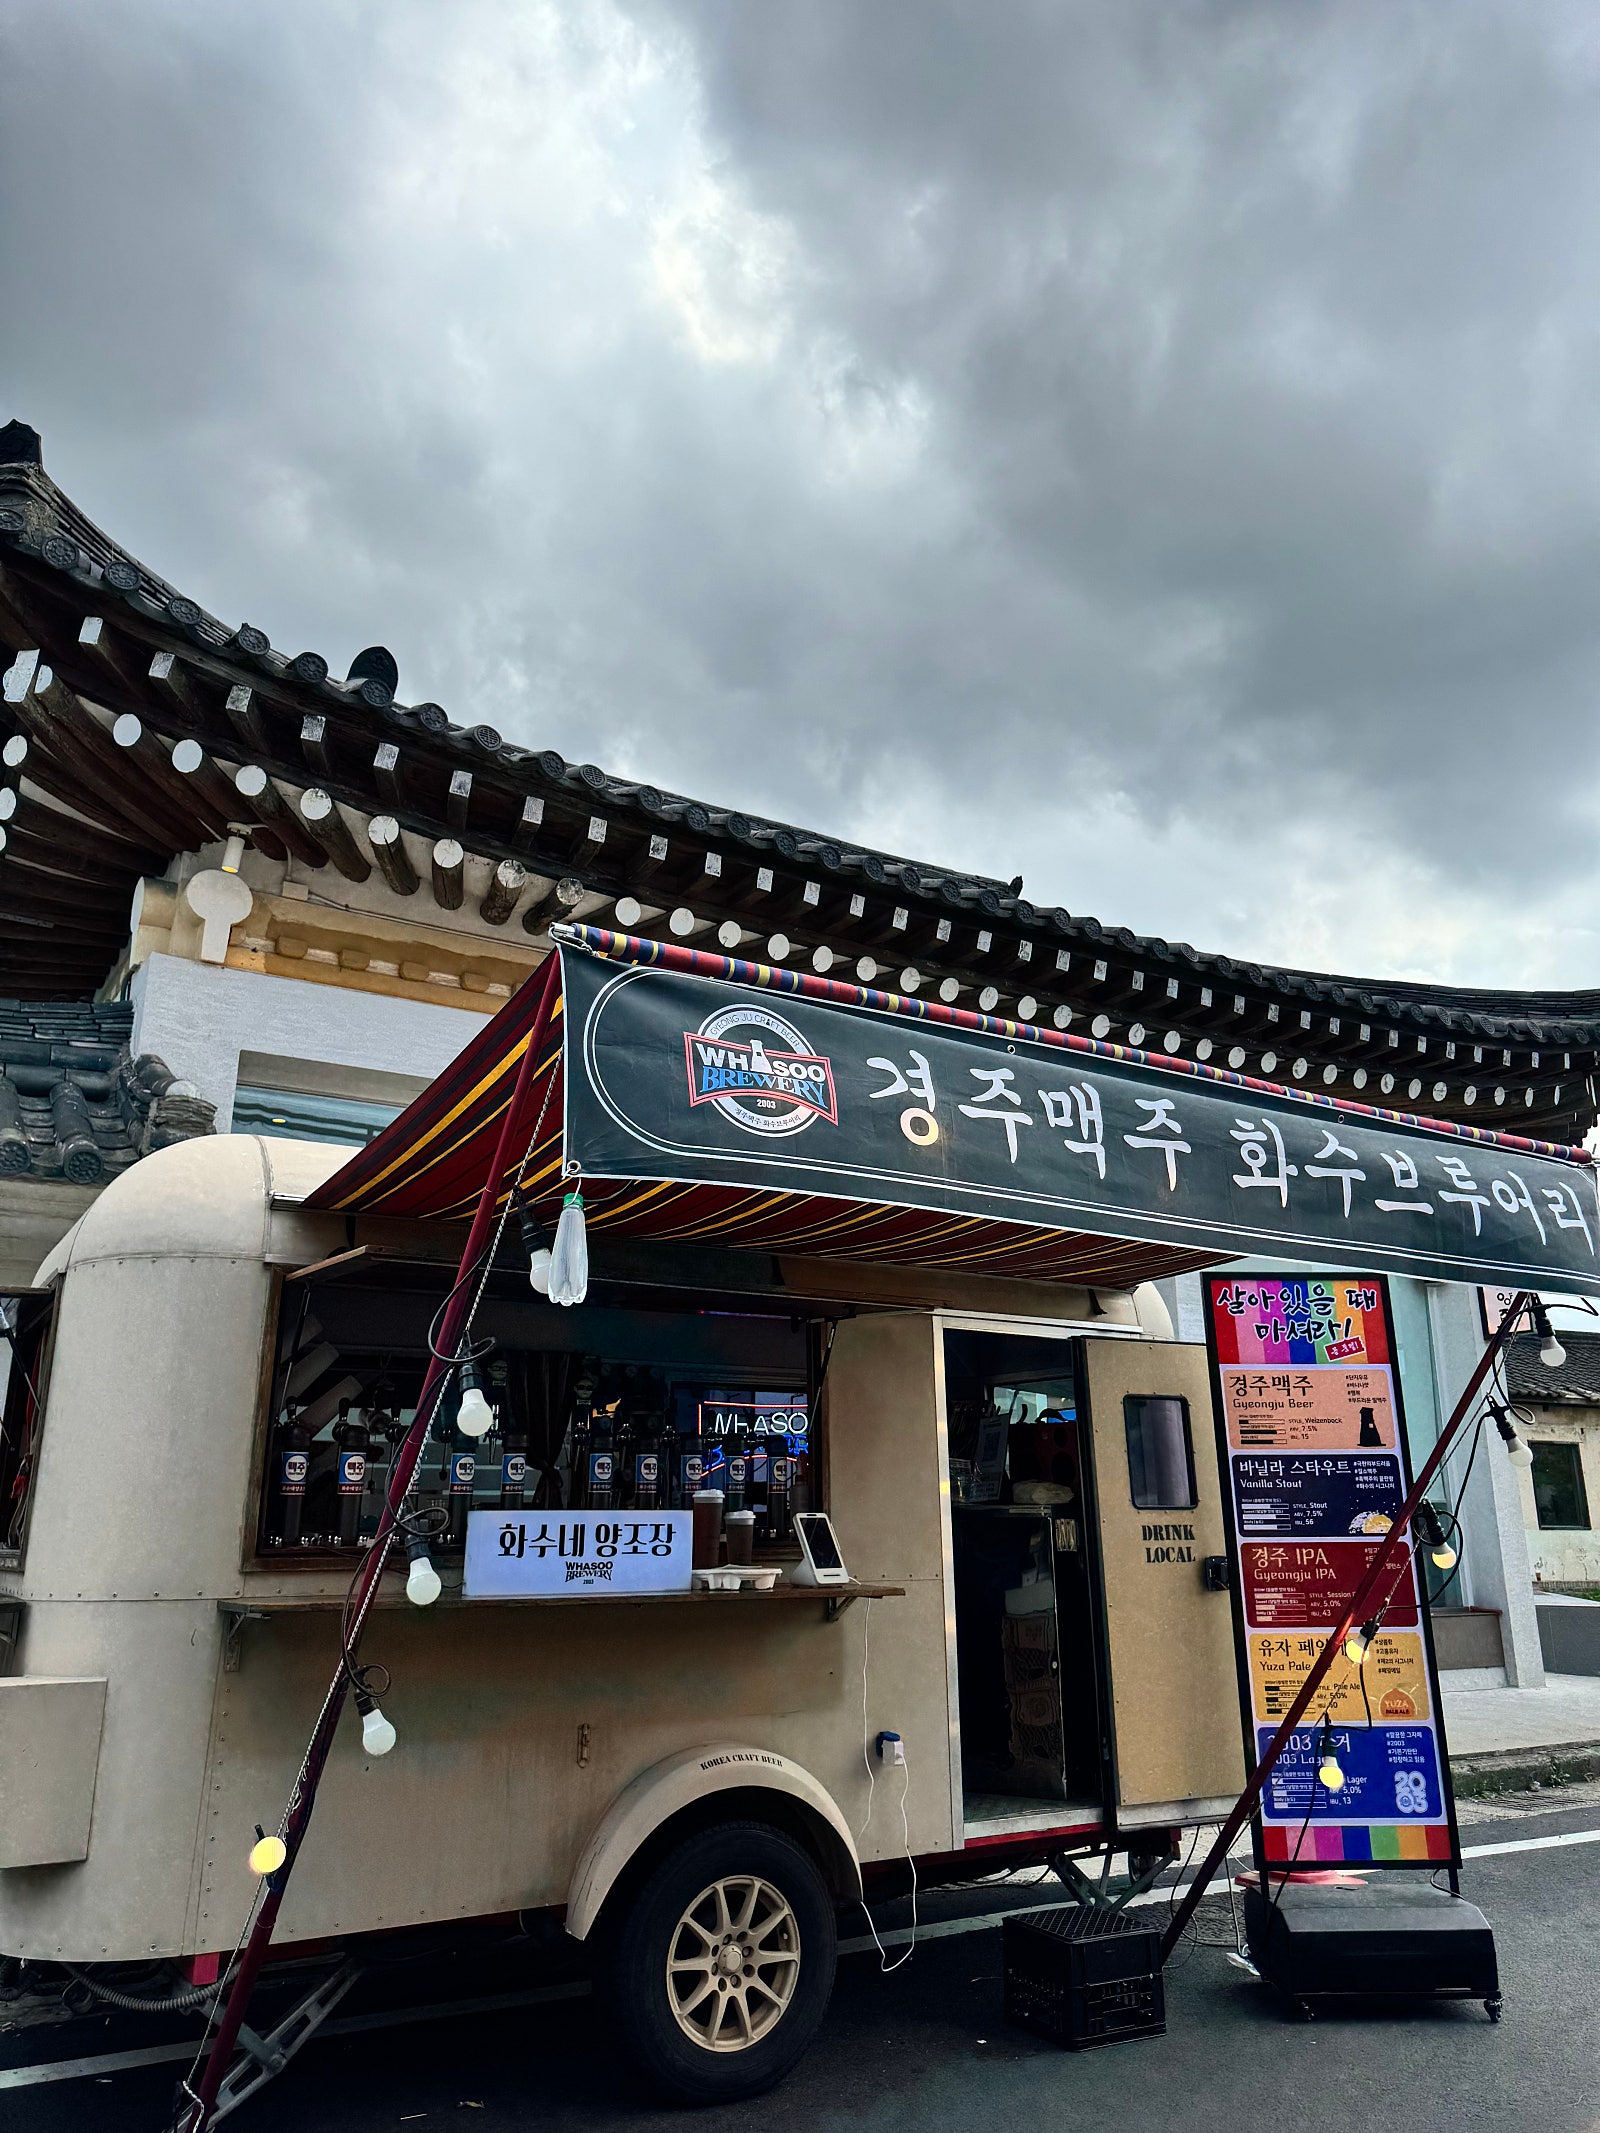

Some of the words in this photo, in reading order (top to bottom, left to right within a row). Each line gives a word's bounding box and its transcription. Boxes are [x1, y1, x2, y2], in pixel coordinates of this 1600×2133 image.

[710, 1014, 740, 1036] GYEONG
[780, 1027, 800, 1047] BEER
[699, 1065, 829, 1109] BREWERY
[756, 1099, 776, 1109] 2003
[866, 1049, 1193, 1193] 경주맥주
[1229, 1117, 1595, 1256] 화수브루어리
[1217, 1284, 1336, 1316] 살아있을
[1345, 1288, 1377, 1312] 때
[1254, 1317, 1353, 1344] 마셔라!
[1229, 1374, 1314, 1397] 경주맥주
[1233, 1398, 1285, 1410] Gyeongju
[1288, 1398, 1314, 1408] Beer
[287, 1461, 306, 1472] 맥주
[347, 1462, 364, 1472] 맥주
[459, 1462, 474, 1472] 맥주
[1239, 1459, 1285, 1477] 바닐라
[1290, 1459, 1351, 1477] 스타우트
[1240, 1478, 1273, 1488] Vanilla
[1276, 1479, 1303, 1488] Stout
[1141, 1524, 1196, 1541] DRINK
[498, 1522, 586, 1559] 화수네
[594, 1522, 677, 1558] 양조장
[1145, 1546, 1196, 1563] LOCAL
[1252, 1546, 1289, 1568] 경주
[1296, 1548, 1330, 1565] IPA
[565, 1560, 614, 1571] WHASOO
[565, 1568, 613, 1583] BREWERY
[1254, 1568, 1312, 1583] Gyeongju
[1315, 1568, 1337, 1580] IPA
[1322, 1609, 1331, 1617] 43
[1258, 1638, 1292, 1657] 유자
[1259, 1660, 1285, 1671] Yuza
[1288, 1660, 1311, 1671] Pale
[1385, 1700, 1409, 1708] YUZA
[700, 1755, 732, 1771] KOREA
[732, 1753, 760, 1762] CRAFT
[761, 1755, 783, 1768] BEER
[1346, 1775, 1368, 1785] Lager
[1343, 1786, 1362, 1794] 5.0%
[1342, 1796, 1352, 1804] 13
